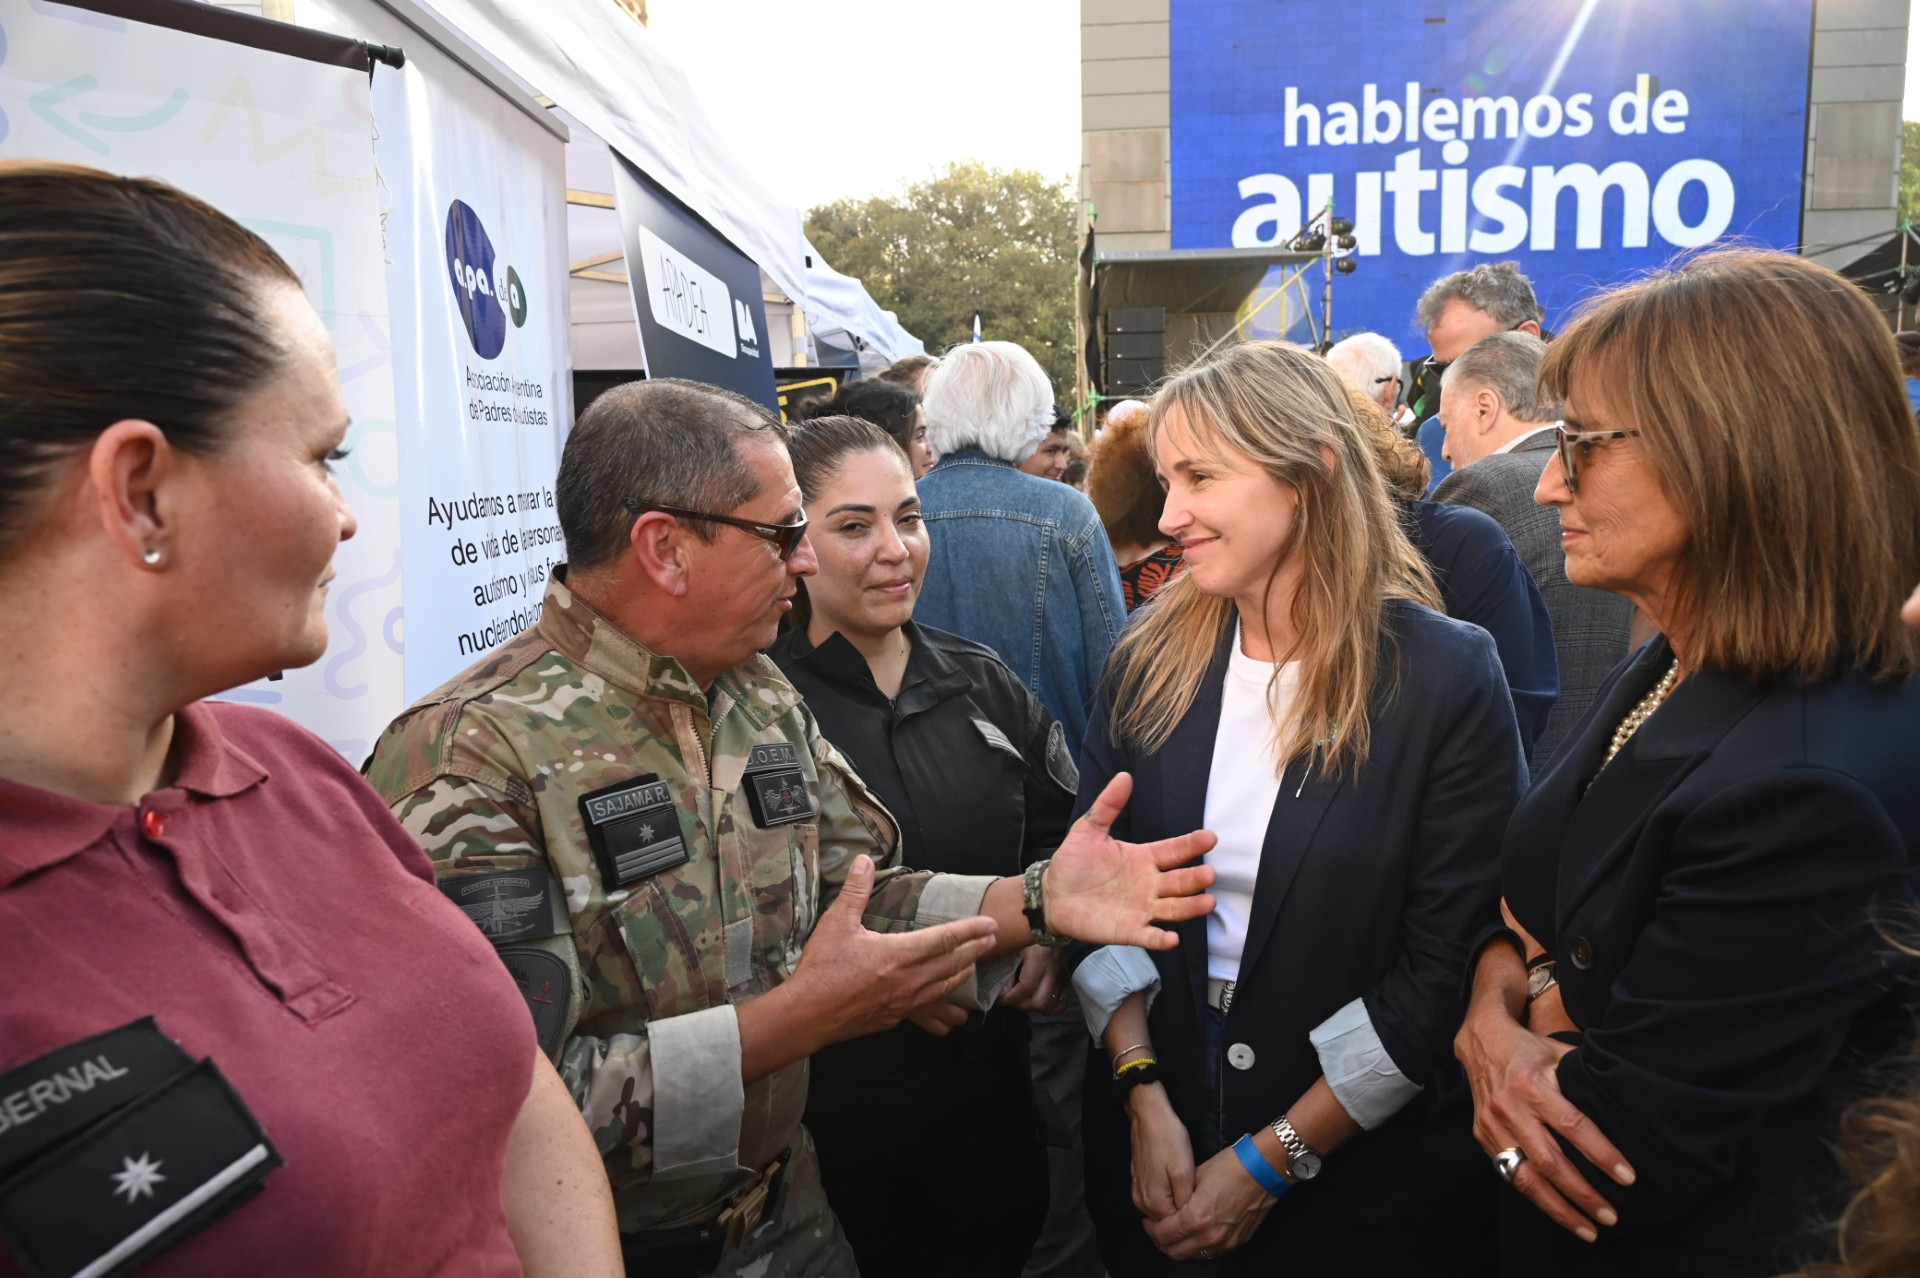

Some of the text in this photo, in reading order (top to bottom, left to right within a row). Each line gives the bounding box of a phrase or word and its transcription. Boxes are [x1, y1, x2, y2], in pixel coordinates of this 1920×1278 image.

[1284, 73, 1689, 147] hablemos de
[1231, 140, 1735, 258] autismo
[466, 365, 511, 393] Asociación
[478, 399, 512, 422] Padres
[519, 404, 548, 426] utistas
[428, 492, 504, 531] Ayudamos
[507, 494, 517, 514] a
[542, 486, 554, 508] la
[451, 538, 478, 566] de
[481, 533, 501, 560] vida
[502, 529, 519, 555] de
[473, 574, 518, 607] autismo
[519, 572, 527, 598] y
[594, 786, 669, 818] SAJAMA R.
